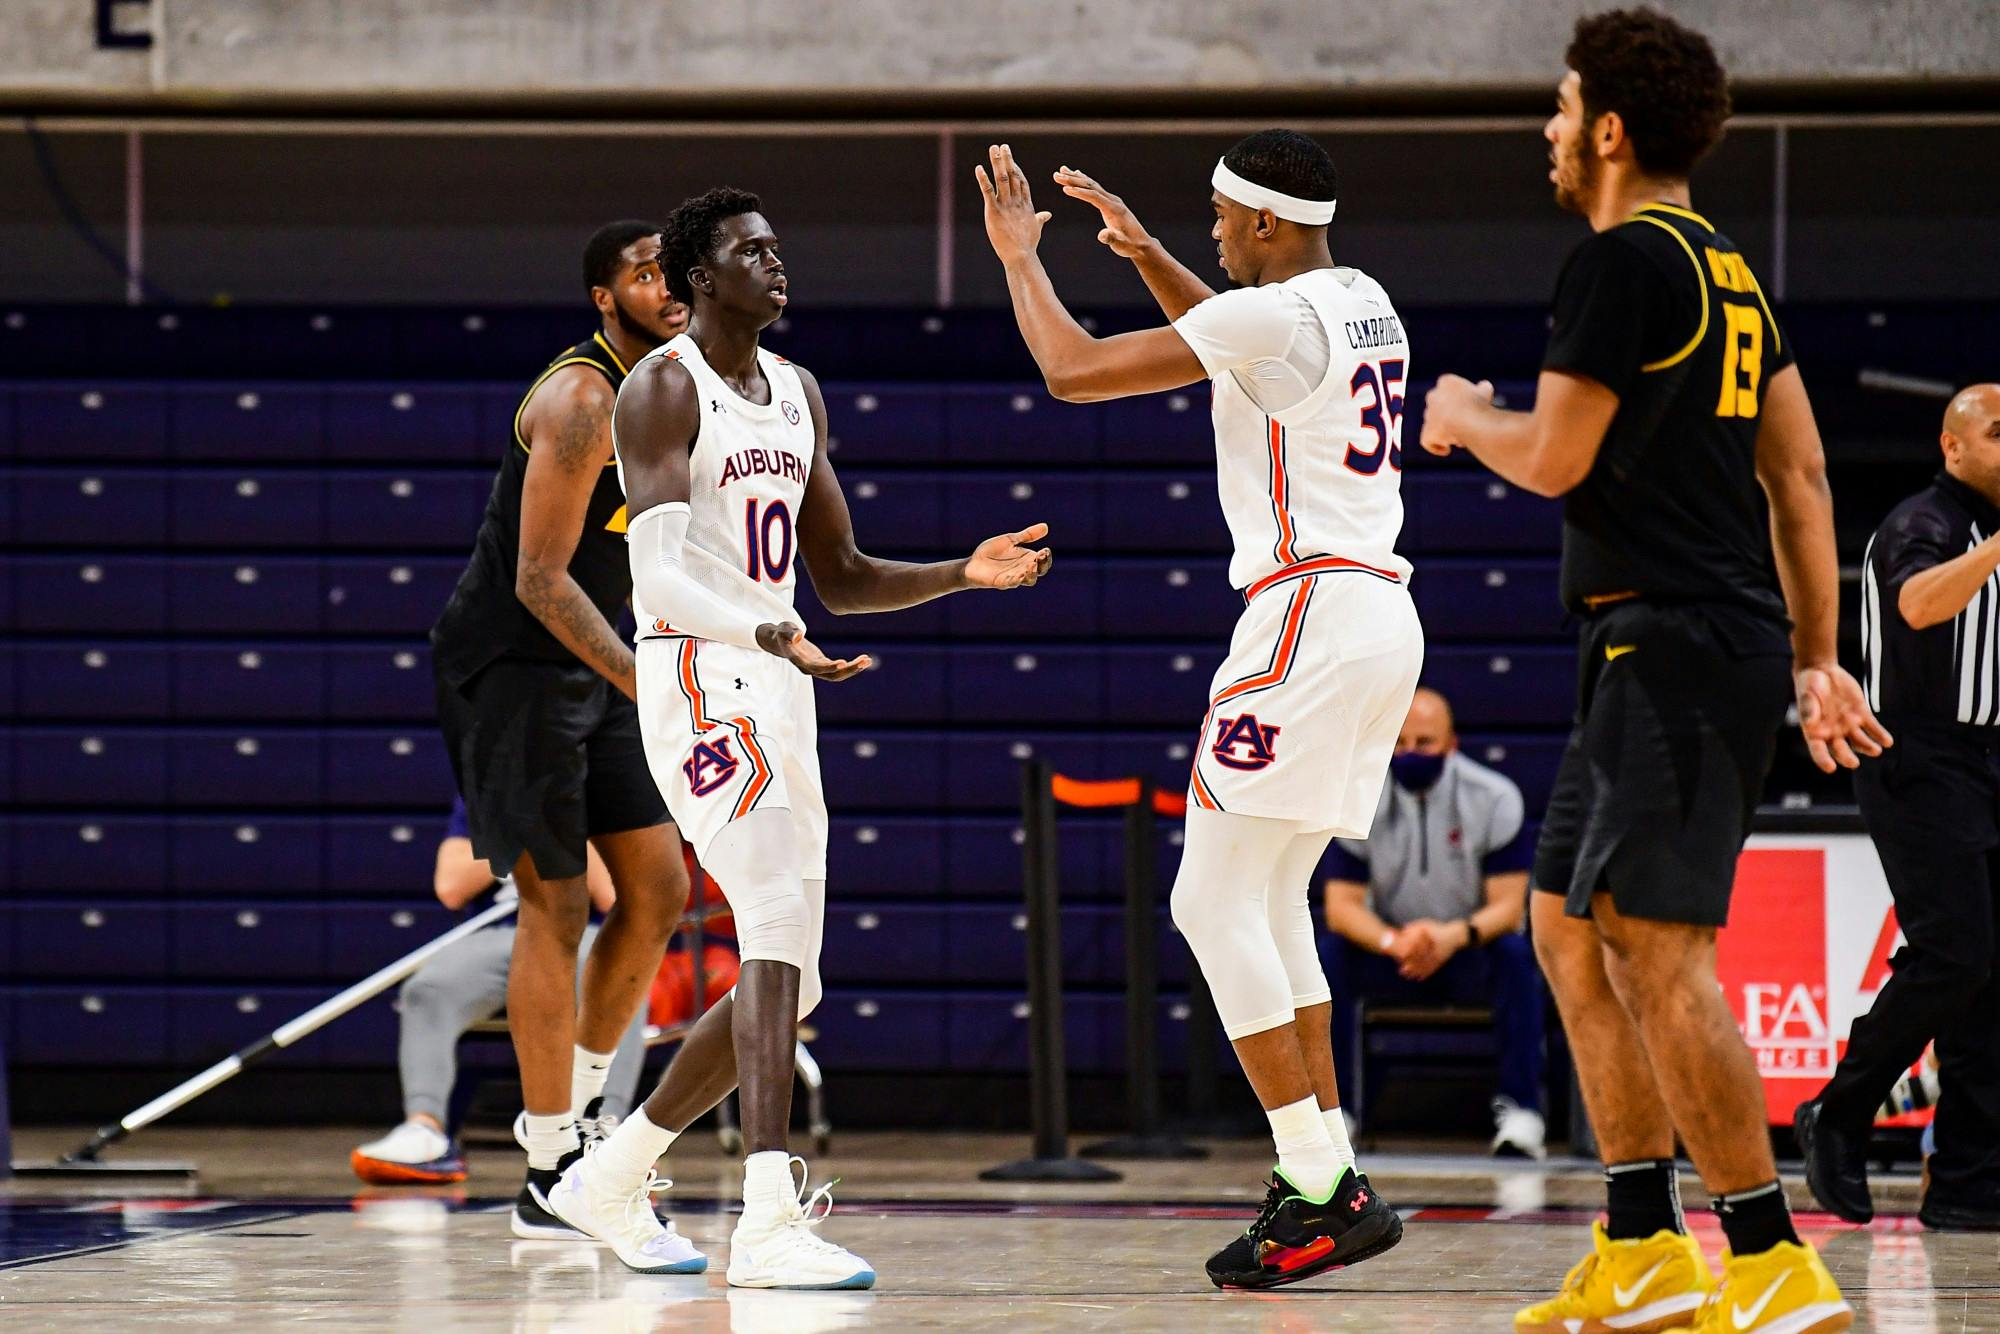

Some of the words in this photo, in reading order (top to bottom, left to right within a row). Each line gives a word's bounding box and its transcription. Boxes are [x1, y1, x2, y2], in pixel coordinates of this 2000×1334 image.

[1345, 316, 1403, 349] CAMBRIDGE
[1715, 302, 1763, 418] 13
[1343, 359, 1404, 476] 35
[719, 448, 807, 489] AUBURN
[745, 498, 792, 584] 10
